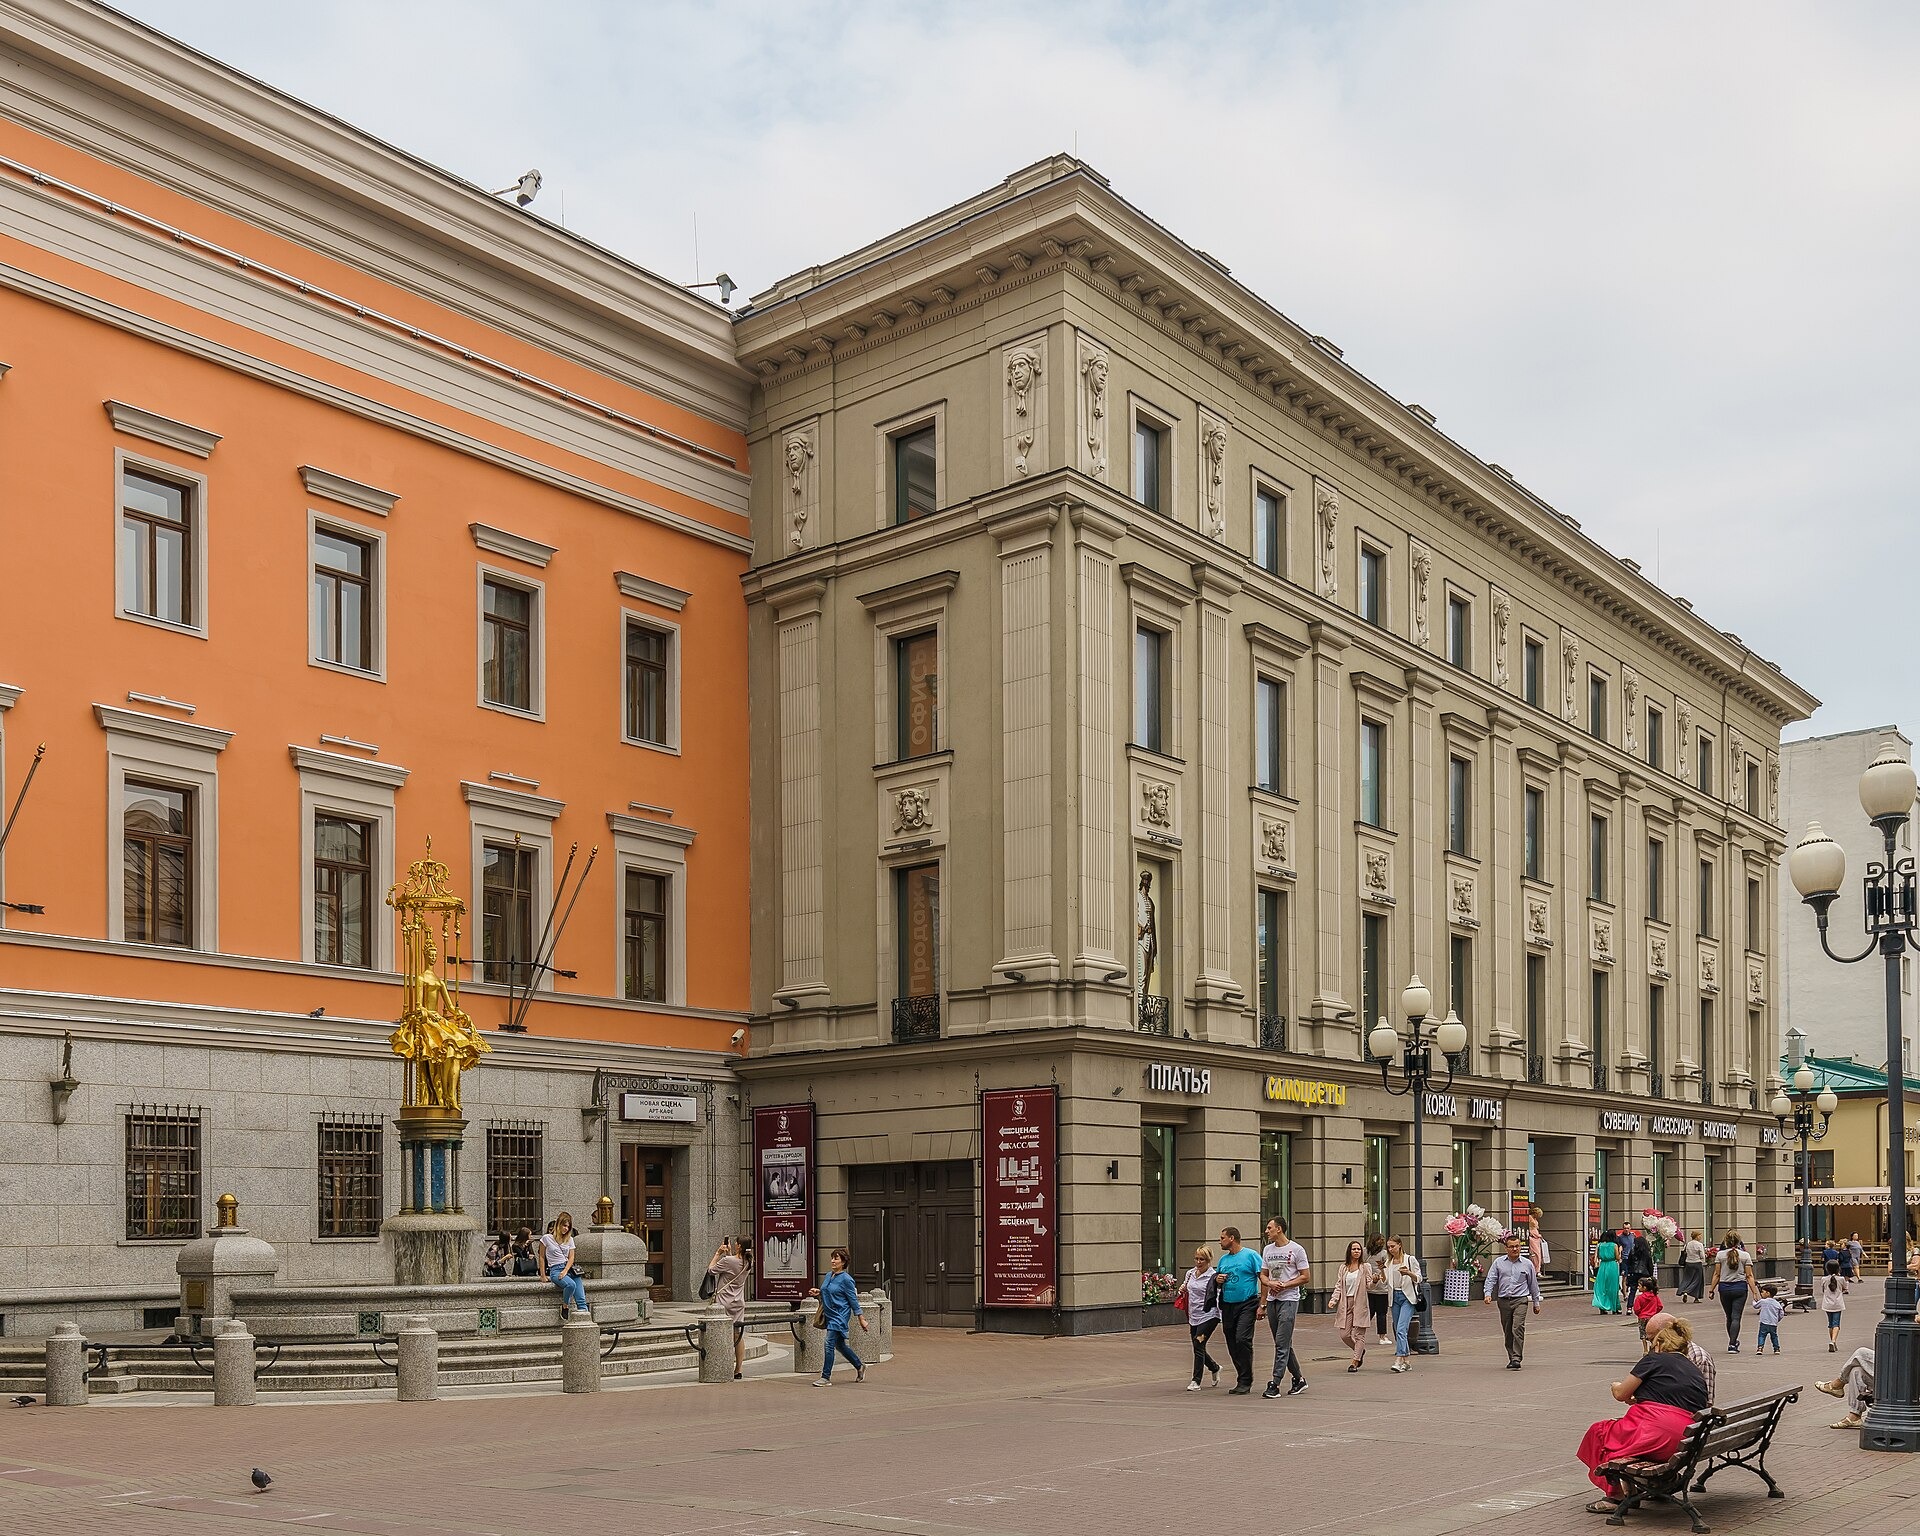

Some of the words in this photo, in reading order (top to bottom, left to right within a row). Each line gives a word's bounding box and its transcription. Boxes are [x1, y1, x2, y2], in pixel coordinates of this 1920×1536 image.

[1151, 1063, 1211, 1094] ПЛАТЬЯ
[1266, 1076, 1346, 1108] САМОЦВЕТЫ
[660, 1100, 682, 1108] СЦЕНА
[1425, 1093, 1457, 1117] КОВКА
[1471, 1098, 1502, 1121] ЛИТЬЕ
[1603, 1111, 1642, 1132] СУВЕНИРЫ
[1652, 1115, 1695, 1136] АКСЕССУАРЫ
[1703, 1120, 1737, 1140] БИЖУТЕРИЯ
[1763, 1128, 1779, 1143] БУСЫ
